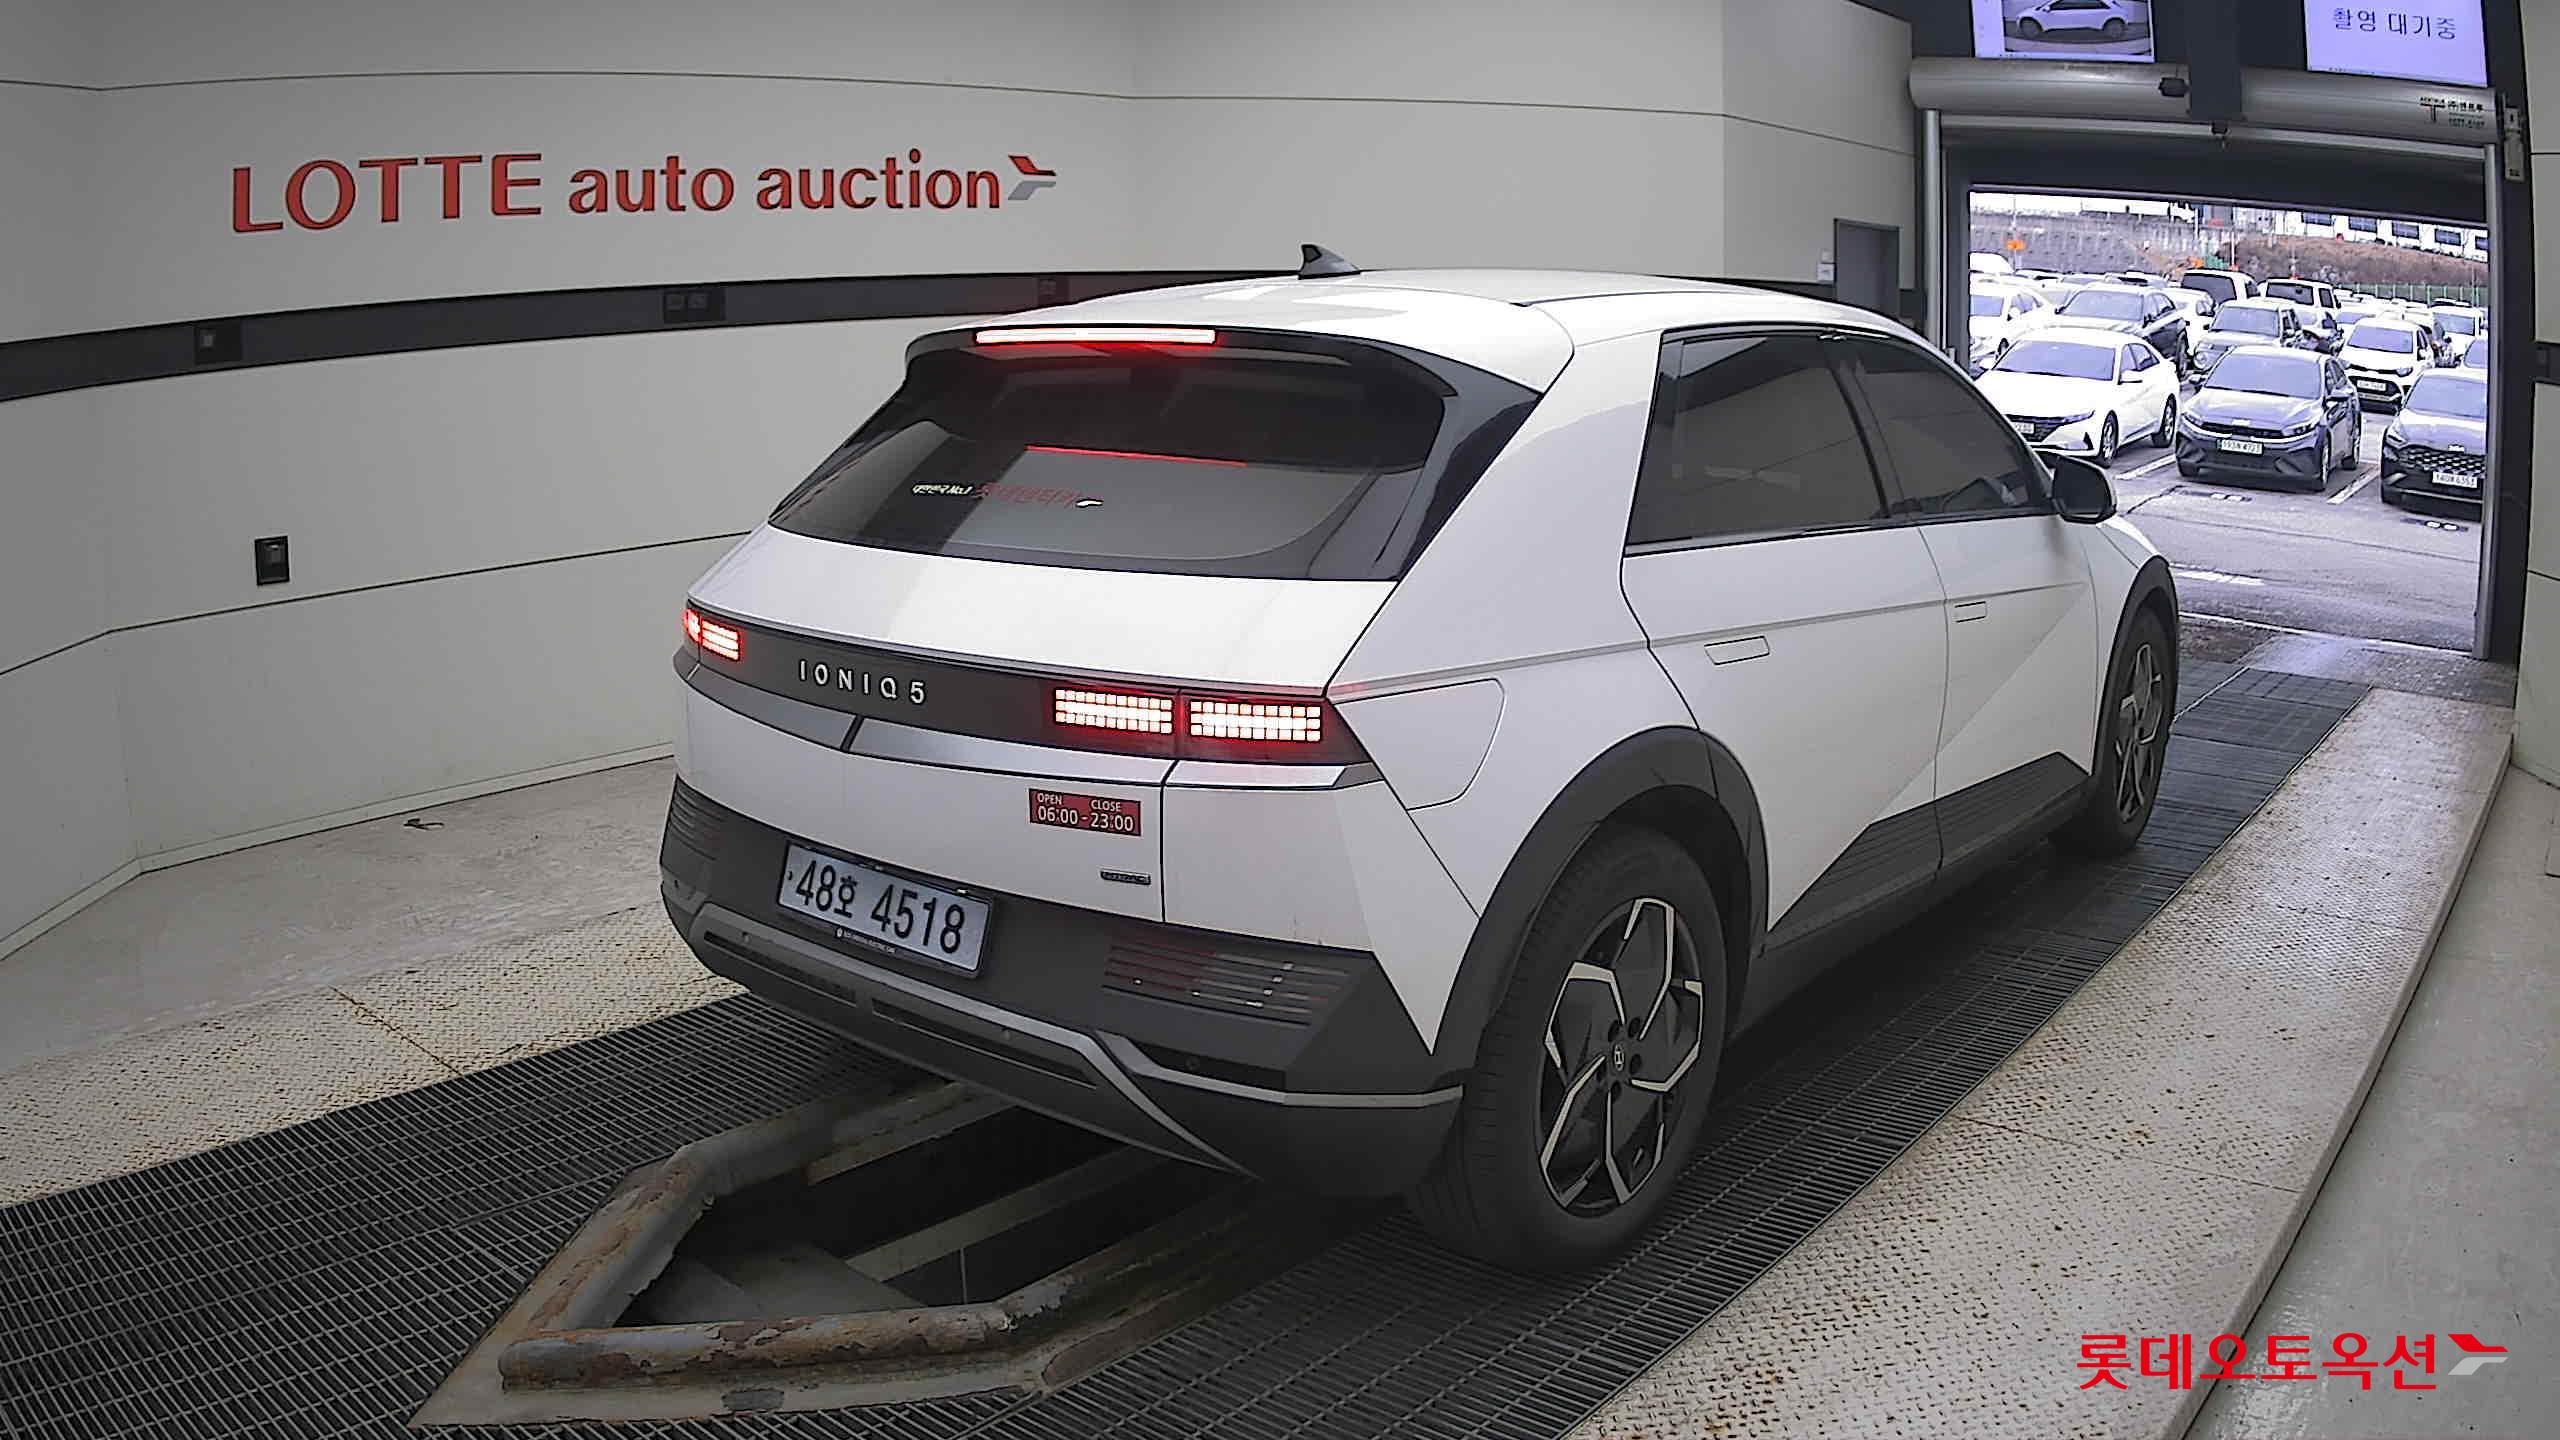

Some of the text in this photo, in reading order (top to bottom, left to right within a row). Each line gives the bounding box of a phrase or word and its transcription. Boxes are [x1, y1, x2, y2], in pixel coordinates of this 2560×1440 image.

[2334, 7, 2456, 40] 촬영 대기중
[233, 148, 1001, 233] LOTTE auto auction
[800, 660, 925, 704] IONIQ 5
[1037, 792, 1121, 812] OPEN CLOSE
[1038, 805, 1078, 825] 06:00
[1090, 812, 1134, 831] 23:00
[796, 860, 966, 954] 48호 4518
